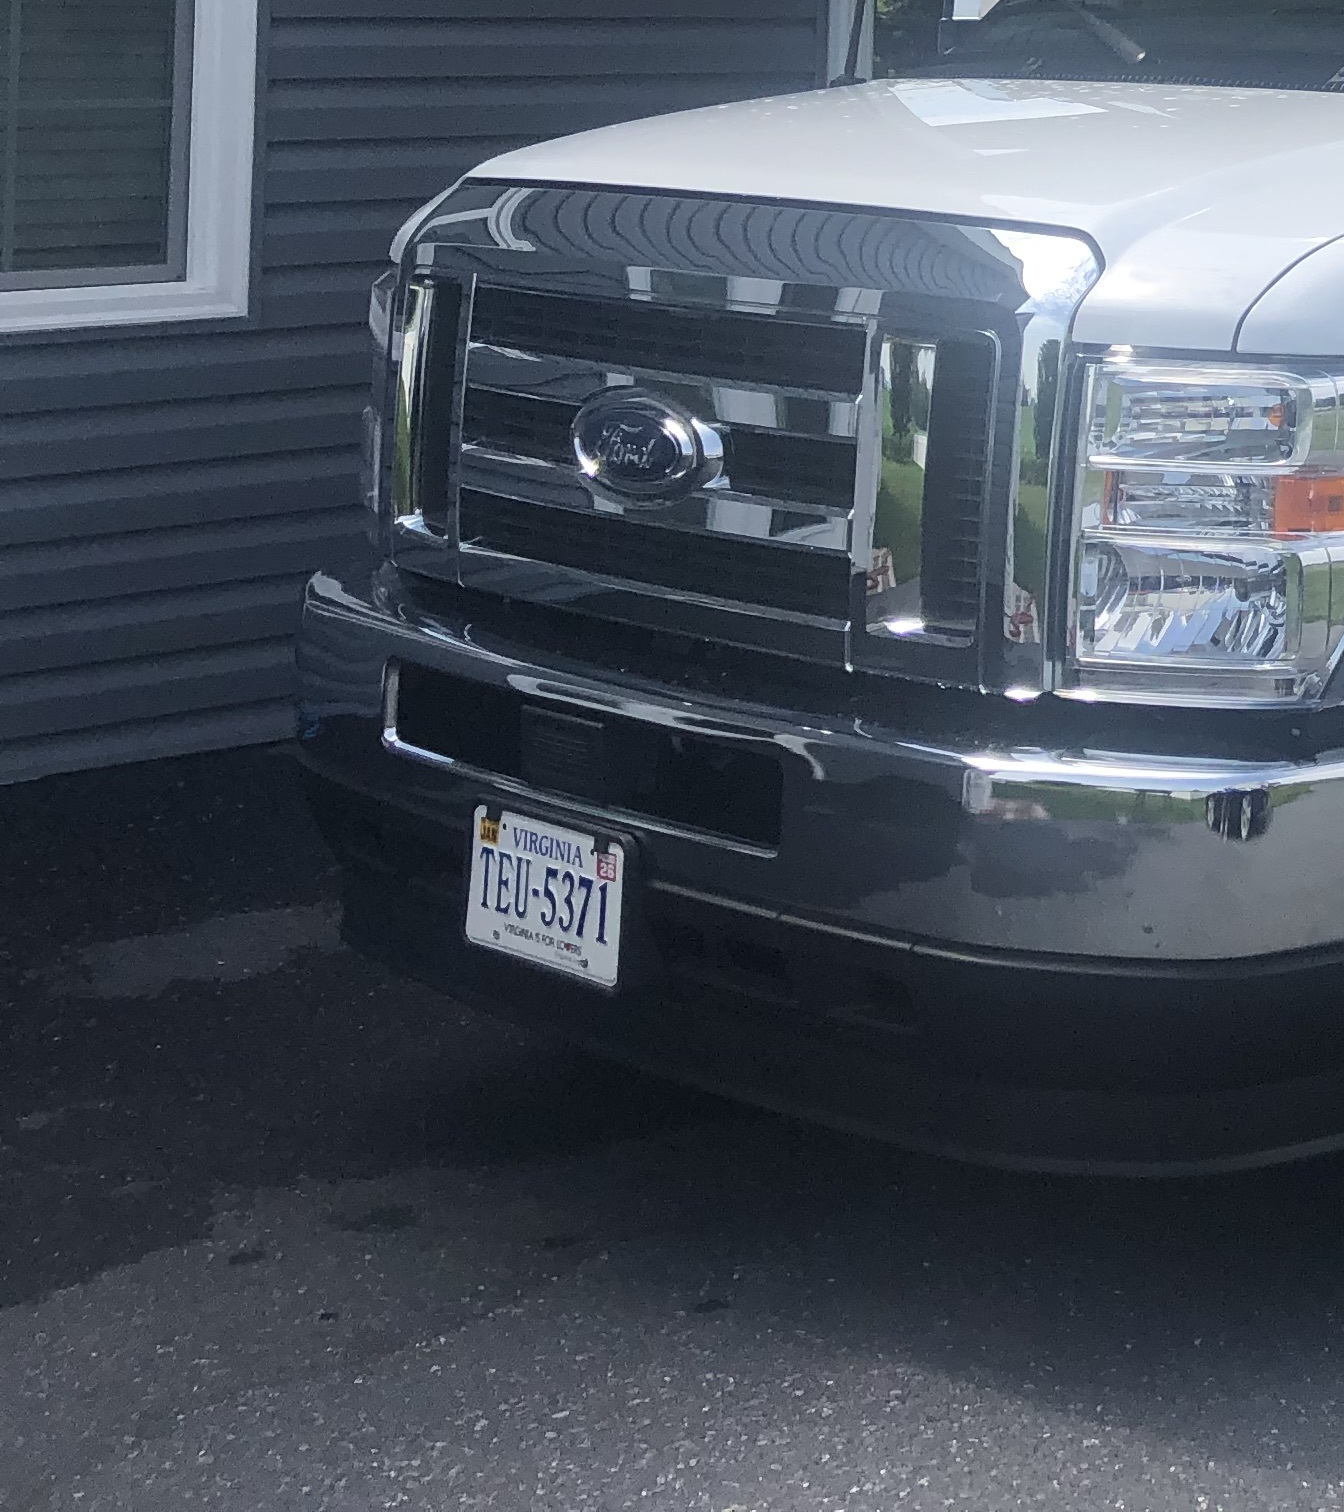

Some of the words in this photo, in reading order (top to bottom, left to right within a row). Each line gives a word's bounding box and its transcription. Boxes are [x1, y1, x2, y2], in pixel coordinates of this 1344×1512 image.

[513, 827, 583, 868] VIRGINIA
[599, 861, 615, 879] 26
[480, 846, 608, 946] TEU-5371
[504, 921, 533, 941] VIRGINIA
[542, 934, 555, 948] FOR
